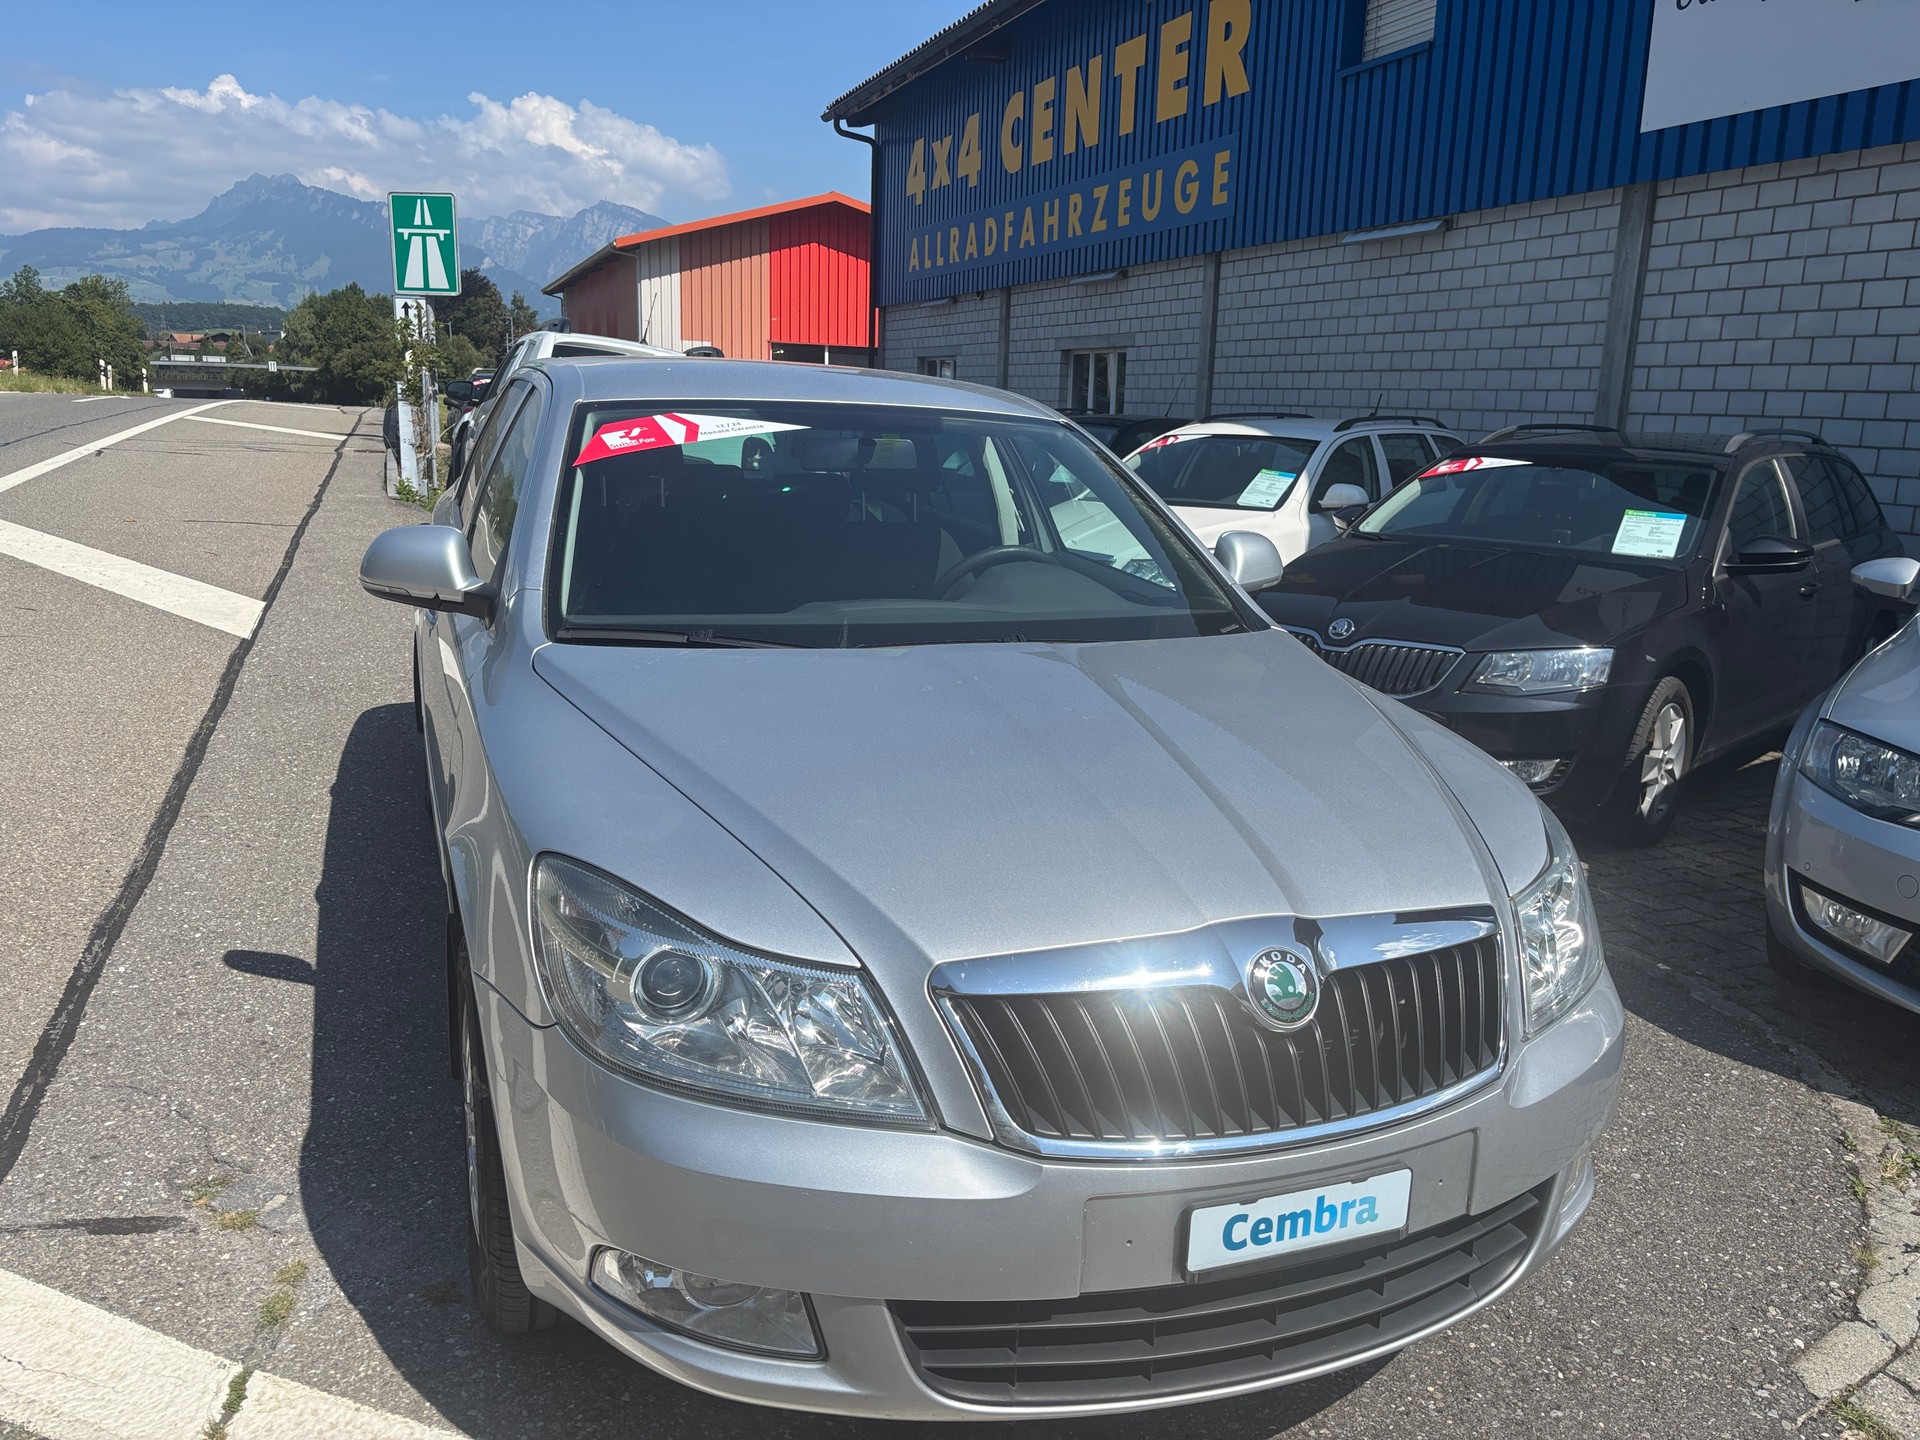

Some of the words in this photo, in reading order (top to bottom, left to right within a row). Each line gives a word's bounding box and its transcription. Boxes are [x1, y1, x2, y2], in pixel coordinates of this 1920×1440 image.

[906, 112, 982, 205] 4x4
[1001, 0, 1251, 174] CENTER
[908, 150, 1231, 272] ALLRADFAHRZEUGE
[700, 428, 730, 436] Monate
[1222, 1195, 1379, 1251] Cembra
